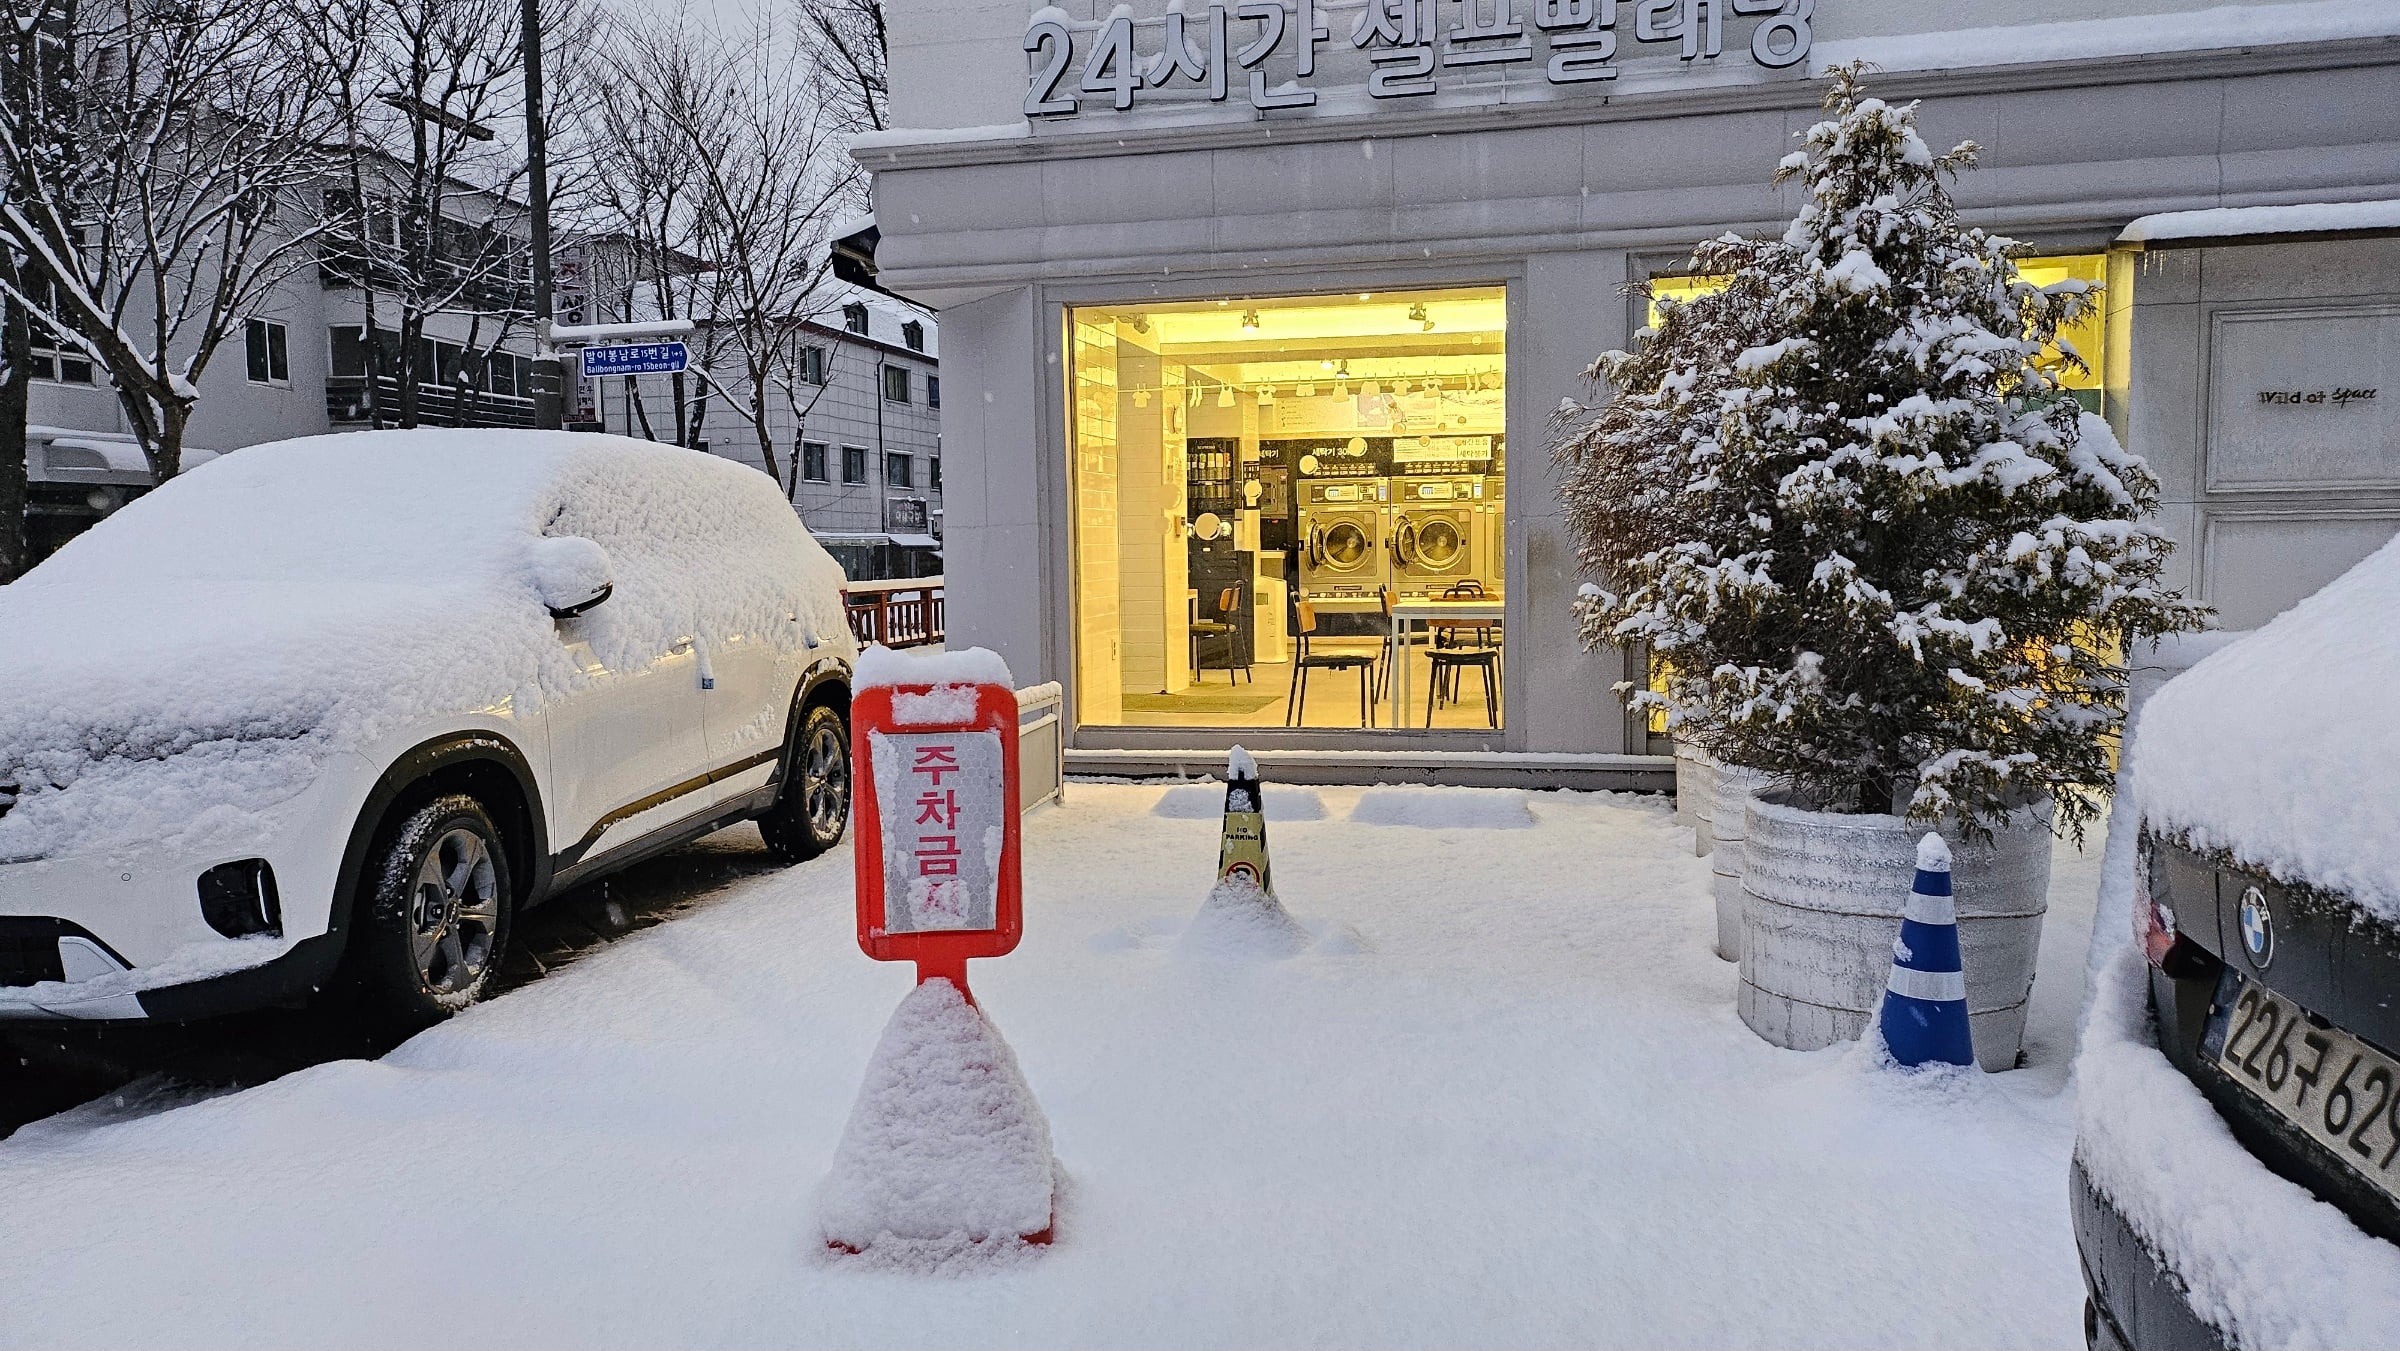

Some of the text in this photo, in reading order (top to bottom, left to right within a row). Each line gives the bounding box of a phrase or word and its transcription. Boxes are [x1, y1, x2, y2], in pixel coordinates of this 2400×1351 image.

[1023, 0, 1329, 116] 24시간
[1311, 447, 1336, 457] 세탁기
[1225, 833, 1259, 841] PARKING
